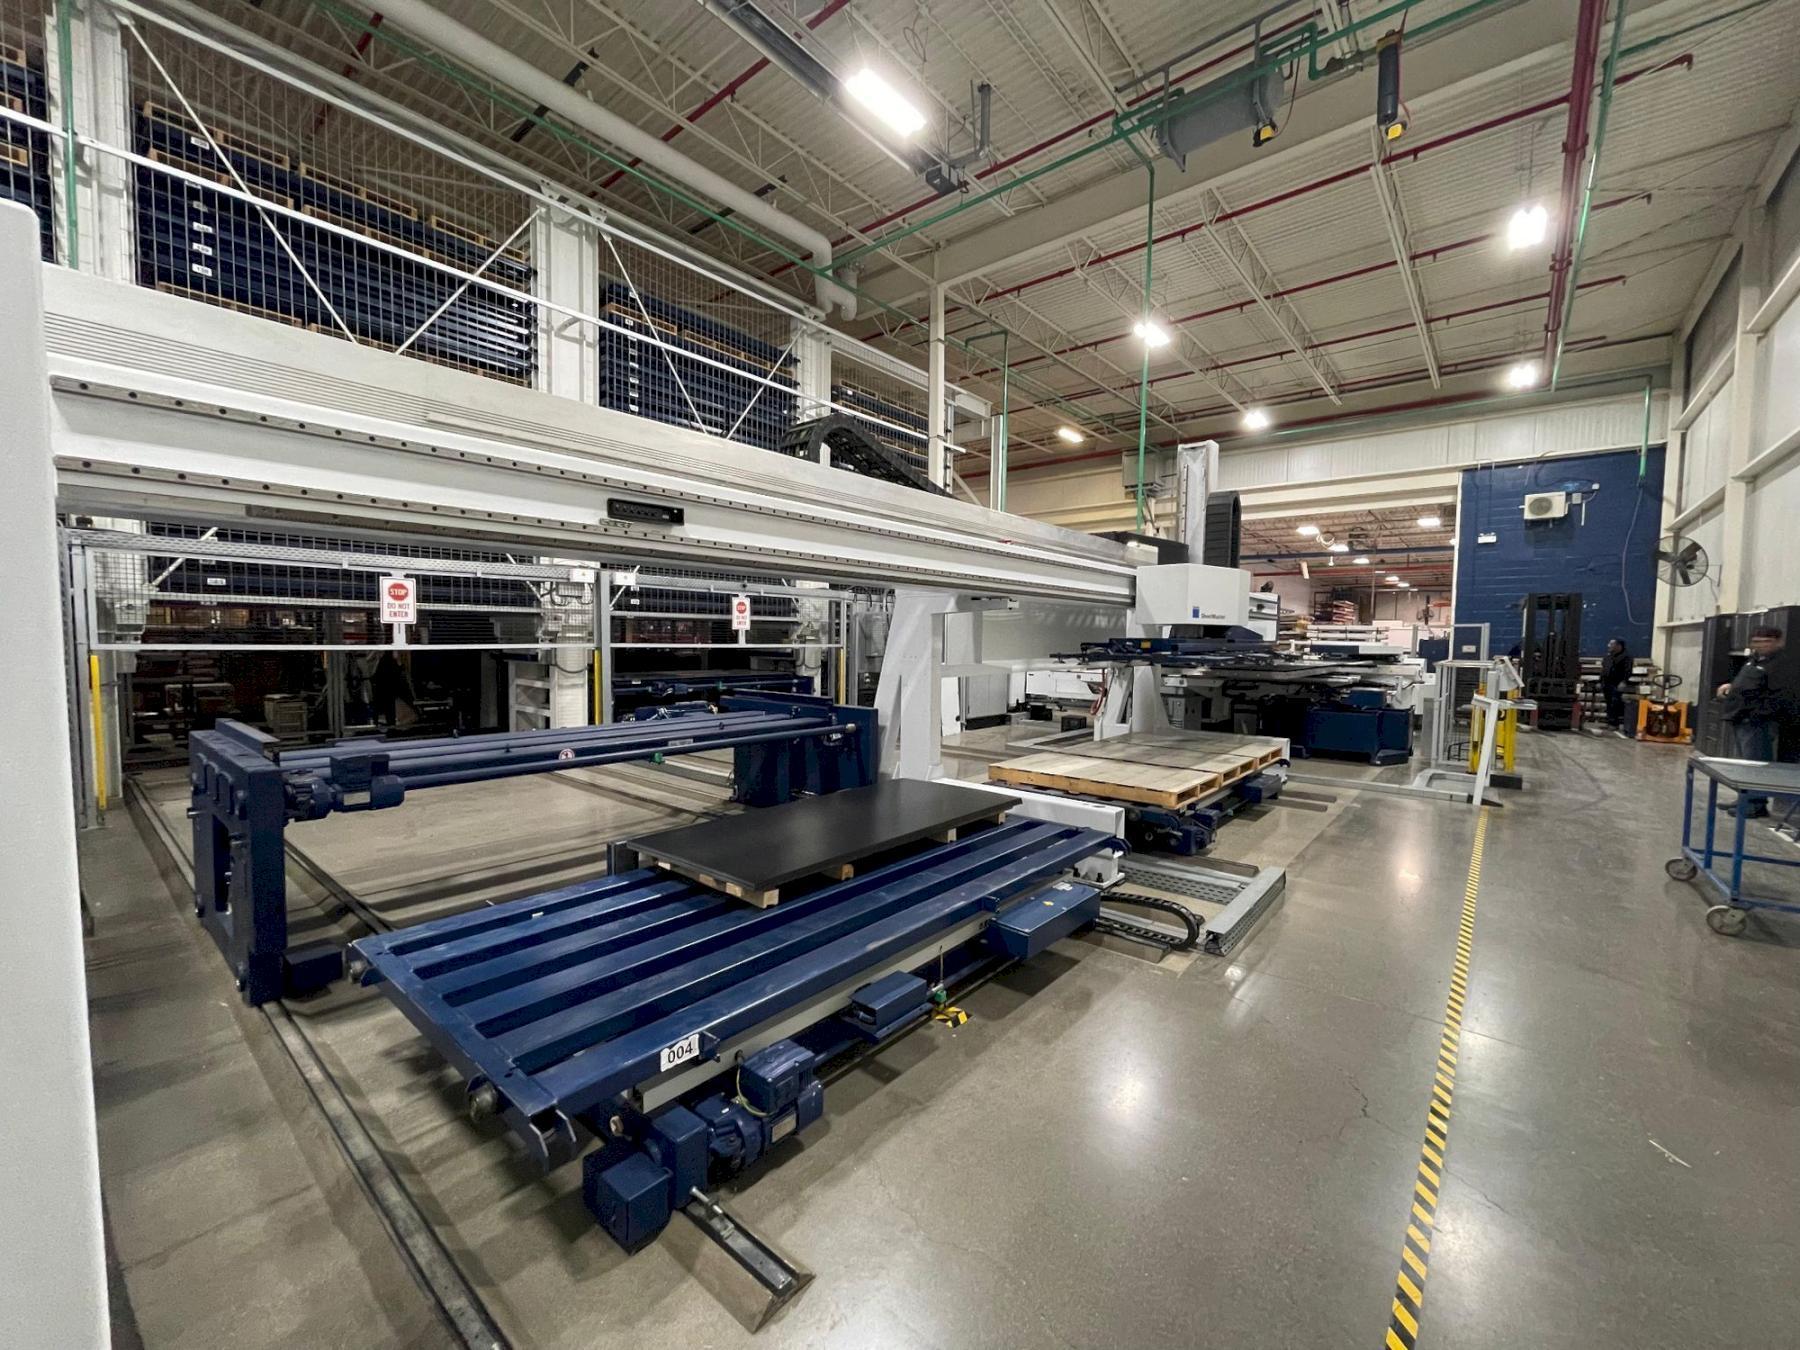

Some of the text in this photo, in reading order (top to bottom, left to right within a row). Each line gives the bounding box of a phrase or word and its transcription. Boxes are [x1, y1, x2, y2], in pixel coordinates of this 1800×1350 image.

[390, 588, 407, 596] STOP
[398, 602, 410, 610] NOT
[389, 610, 408, 618] ENTER
[667, 1041, 693, 1063] 004
